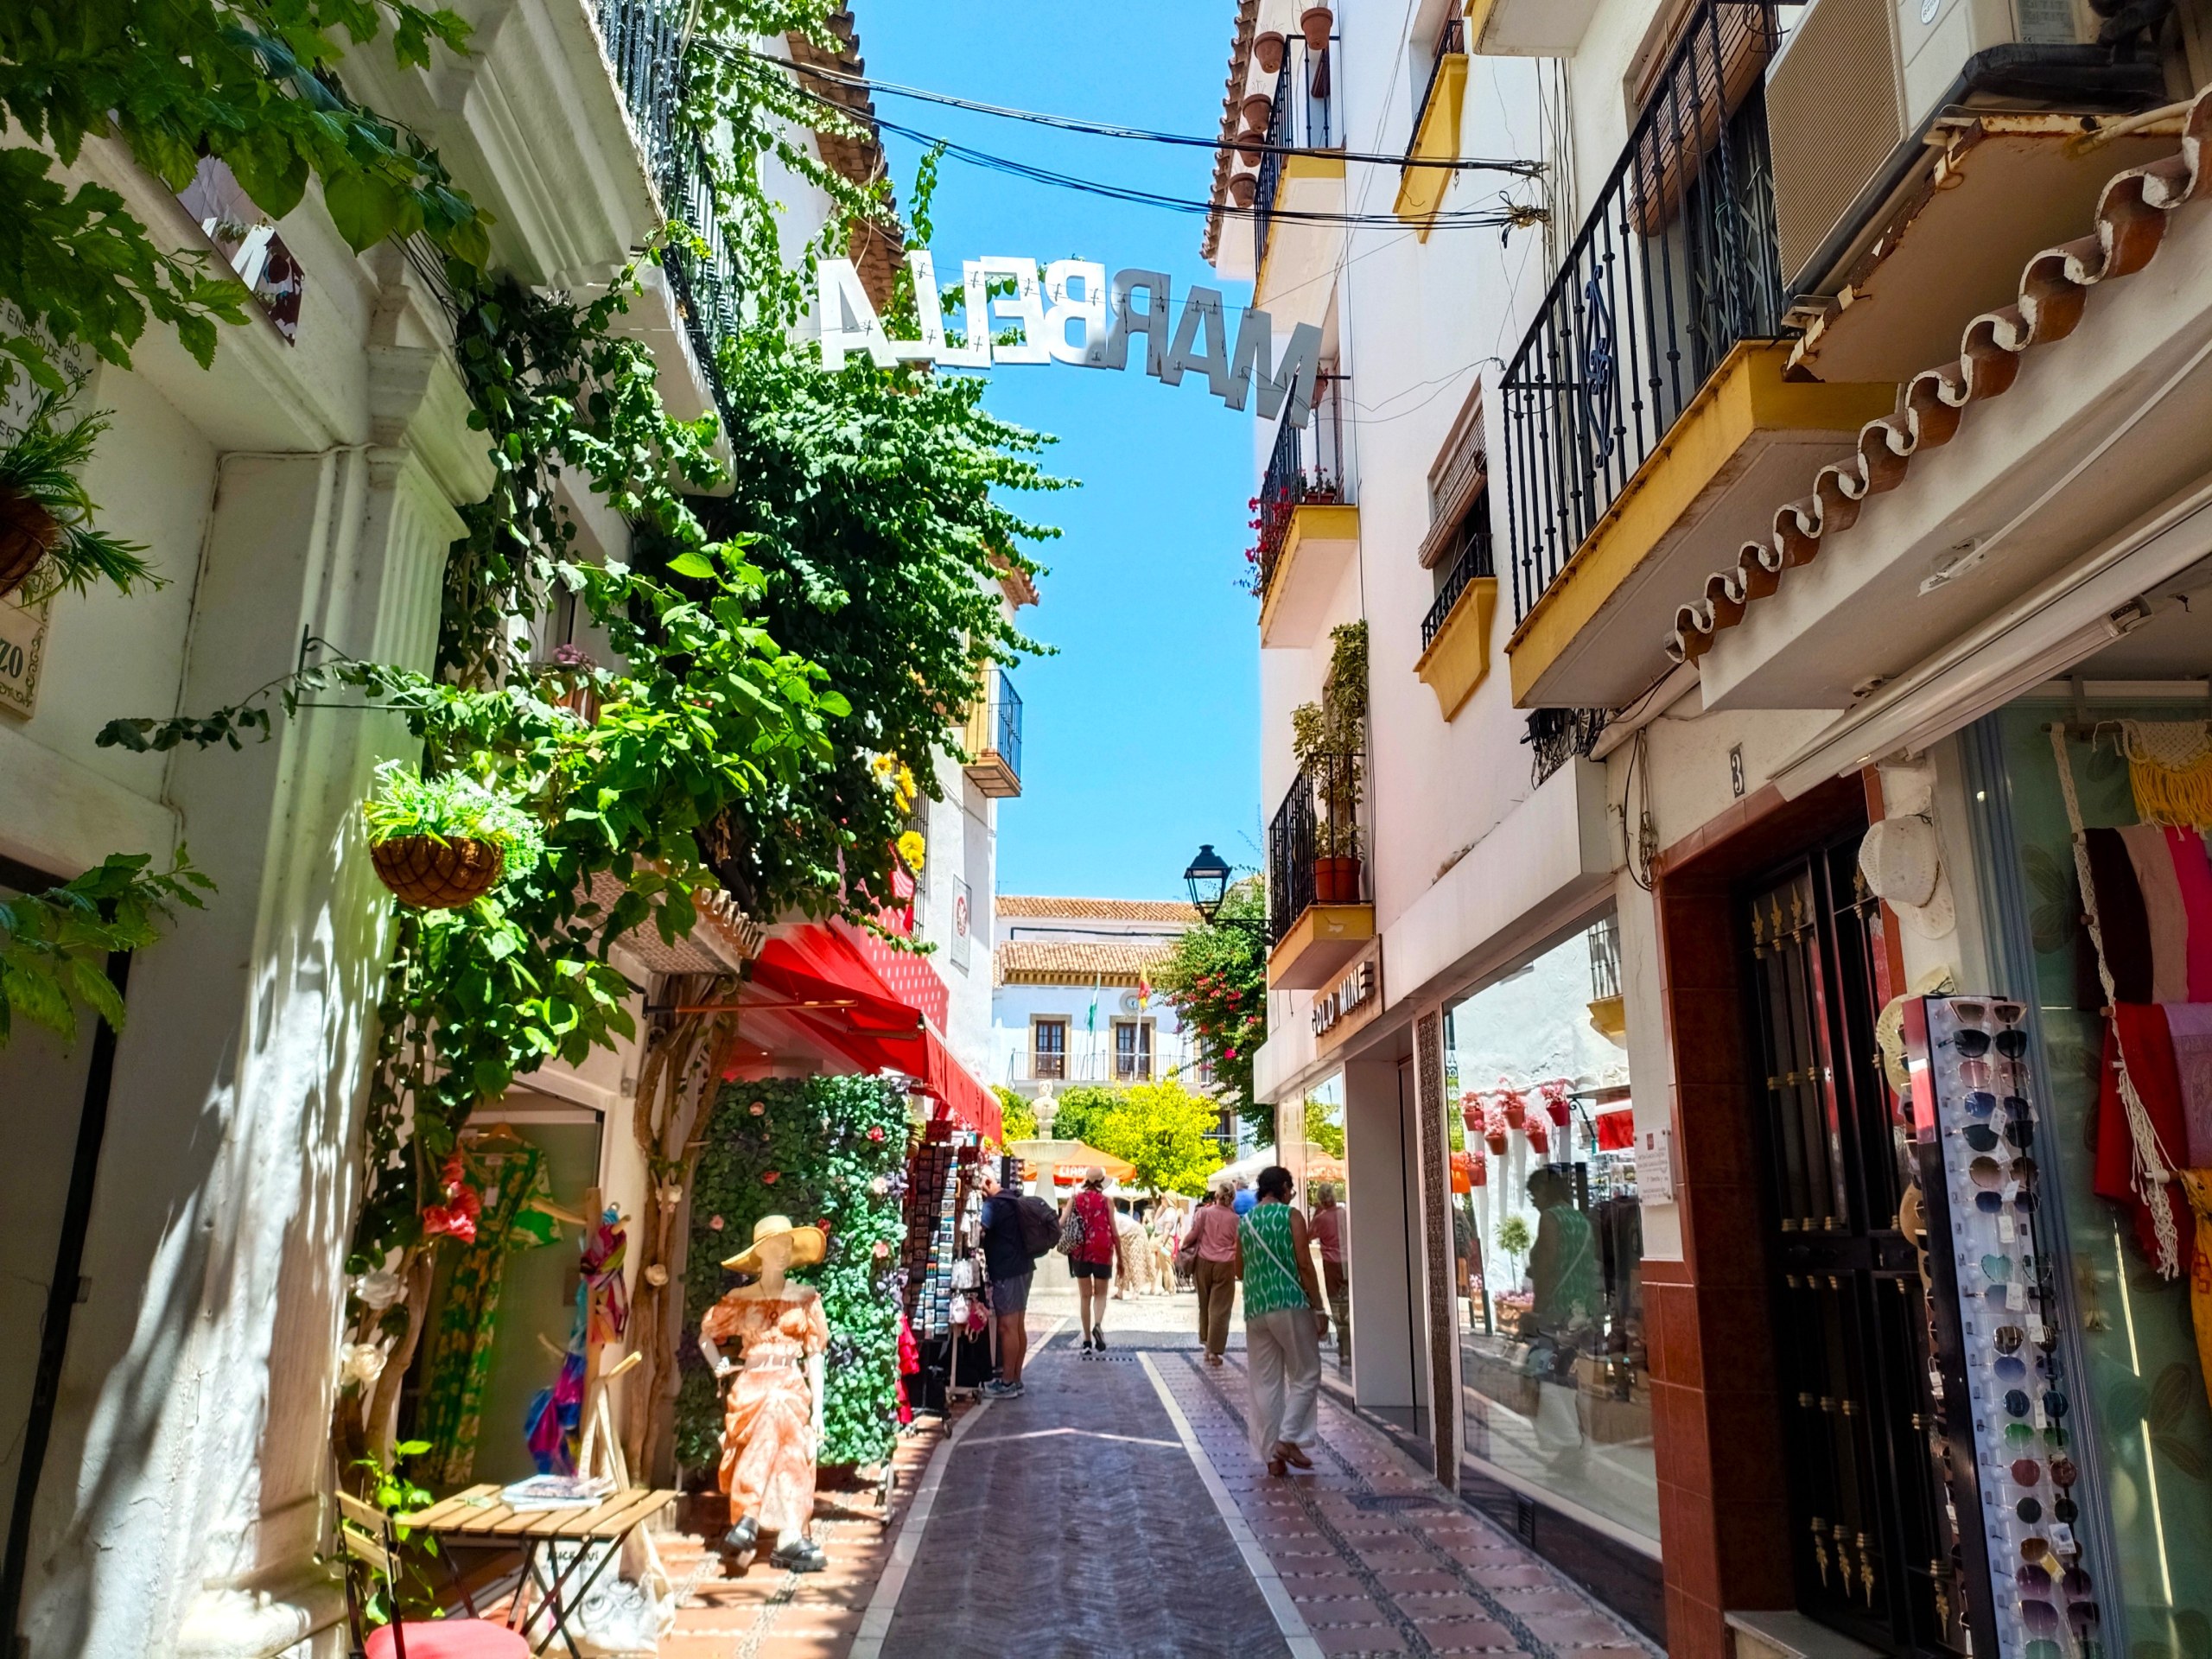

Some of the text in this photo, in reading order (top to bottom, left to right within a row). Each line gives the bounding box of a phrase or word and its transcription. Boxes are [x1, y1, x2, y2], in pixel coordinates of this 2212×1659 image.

[7, 308, 46, 347] ENERO
[47, 343, 61, 364] DE
[1732, 753, 1743, 793] 3
[1311, 962, 1372, 1038] GOLD MINE
